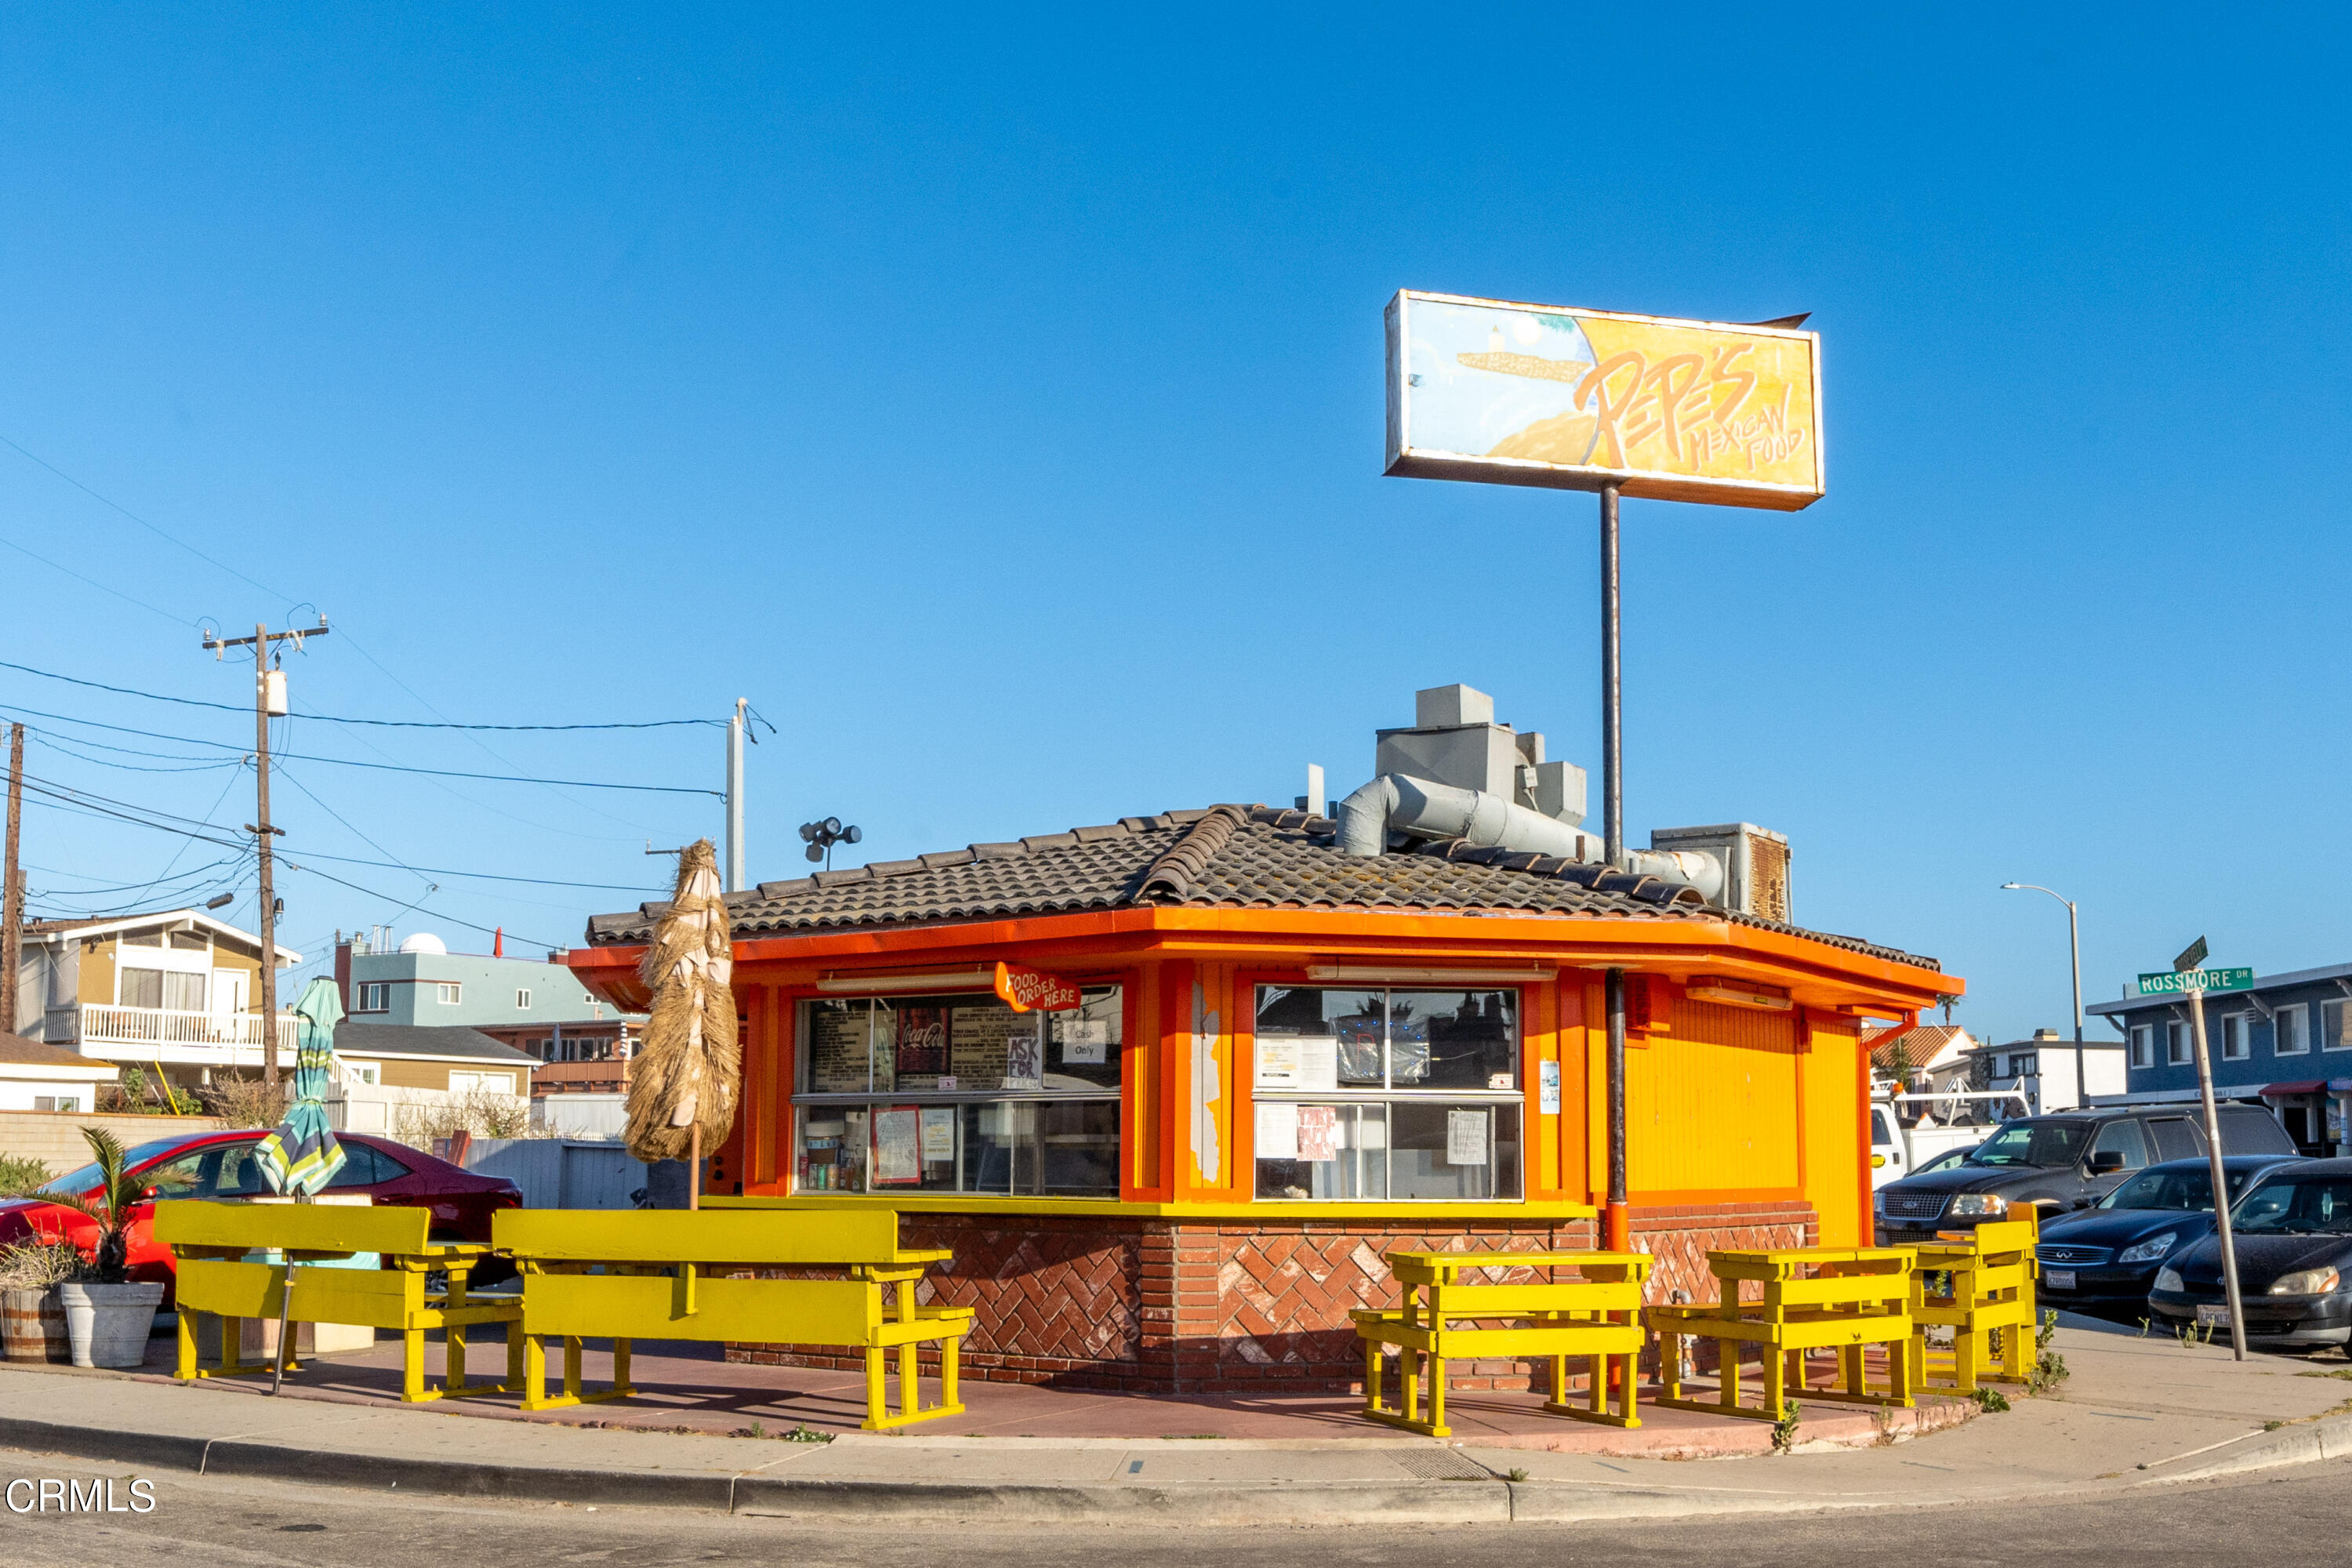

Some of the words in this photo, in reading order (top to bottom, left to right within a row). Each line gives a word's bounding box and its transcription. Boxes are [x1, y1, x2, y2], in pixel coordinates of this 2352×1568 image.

[1573, 343, 1755, 469] PEPE'S
[1690, 382, 1792, 472] MEXICAN
[1746, 427, 1805, 472] FOOD
[1006, 974, 1039, 993] FOOD
[1018, 978, 1056, 1005] ORDER
[2141, 971, 2232, 993] ROSSMORE
[2237, 970, 2249, 978] DR
[1044, 989, 1075, 1007] HERE
[1076, 1029, 1094, 1039] Cash
[1008, 1038, 1039, 1062] ASK
[1075, 1046, 1094, 1056] Only
[1008, 1059, 1036, 1078] FOR
[1298, 1106, 1336, 1127] TAKE
[1298, 1127, 1330, 1145] OUT
[1298, 1142, 1336, 1160] ONLY
